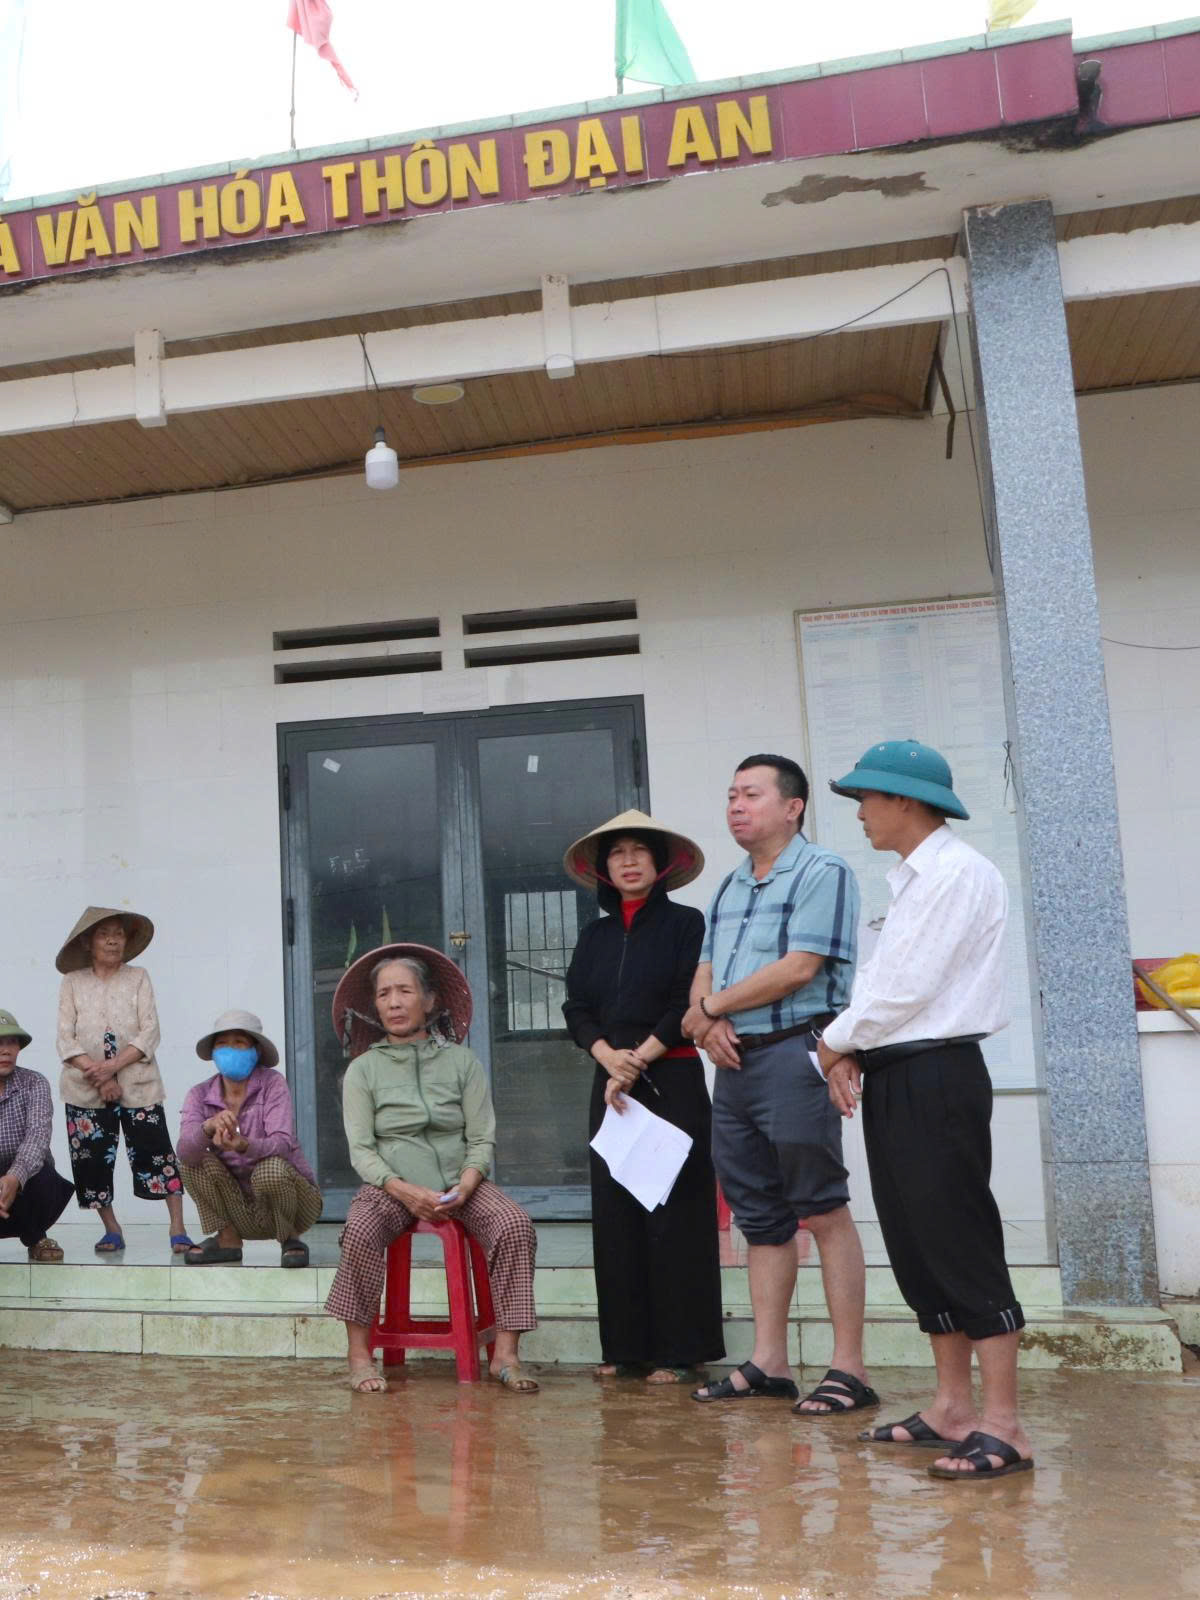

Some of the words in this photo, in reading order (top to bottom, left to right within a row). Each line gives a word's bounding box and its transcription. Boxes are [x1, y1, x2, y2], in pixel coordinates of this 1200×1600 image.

[36, 192, 159, 265] VĂN
[178, 168, 305, 242] HÓA
[322, 139, 499, 219] THÔN
[524, 115, 644, 188] ĐẠI
[666, 95, 773, 167] AN
